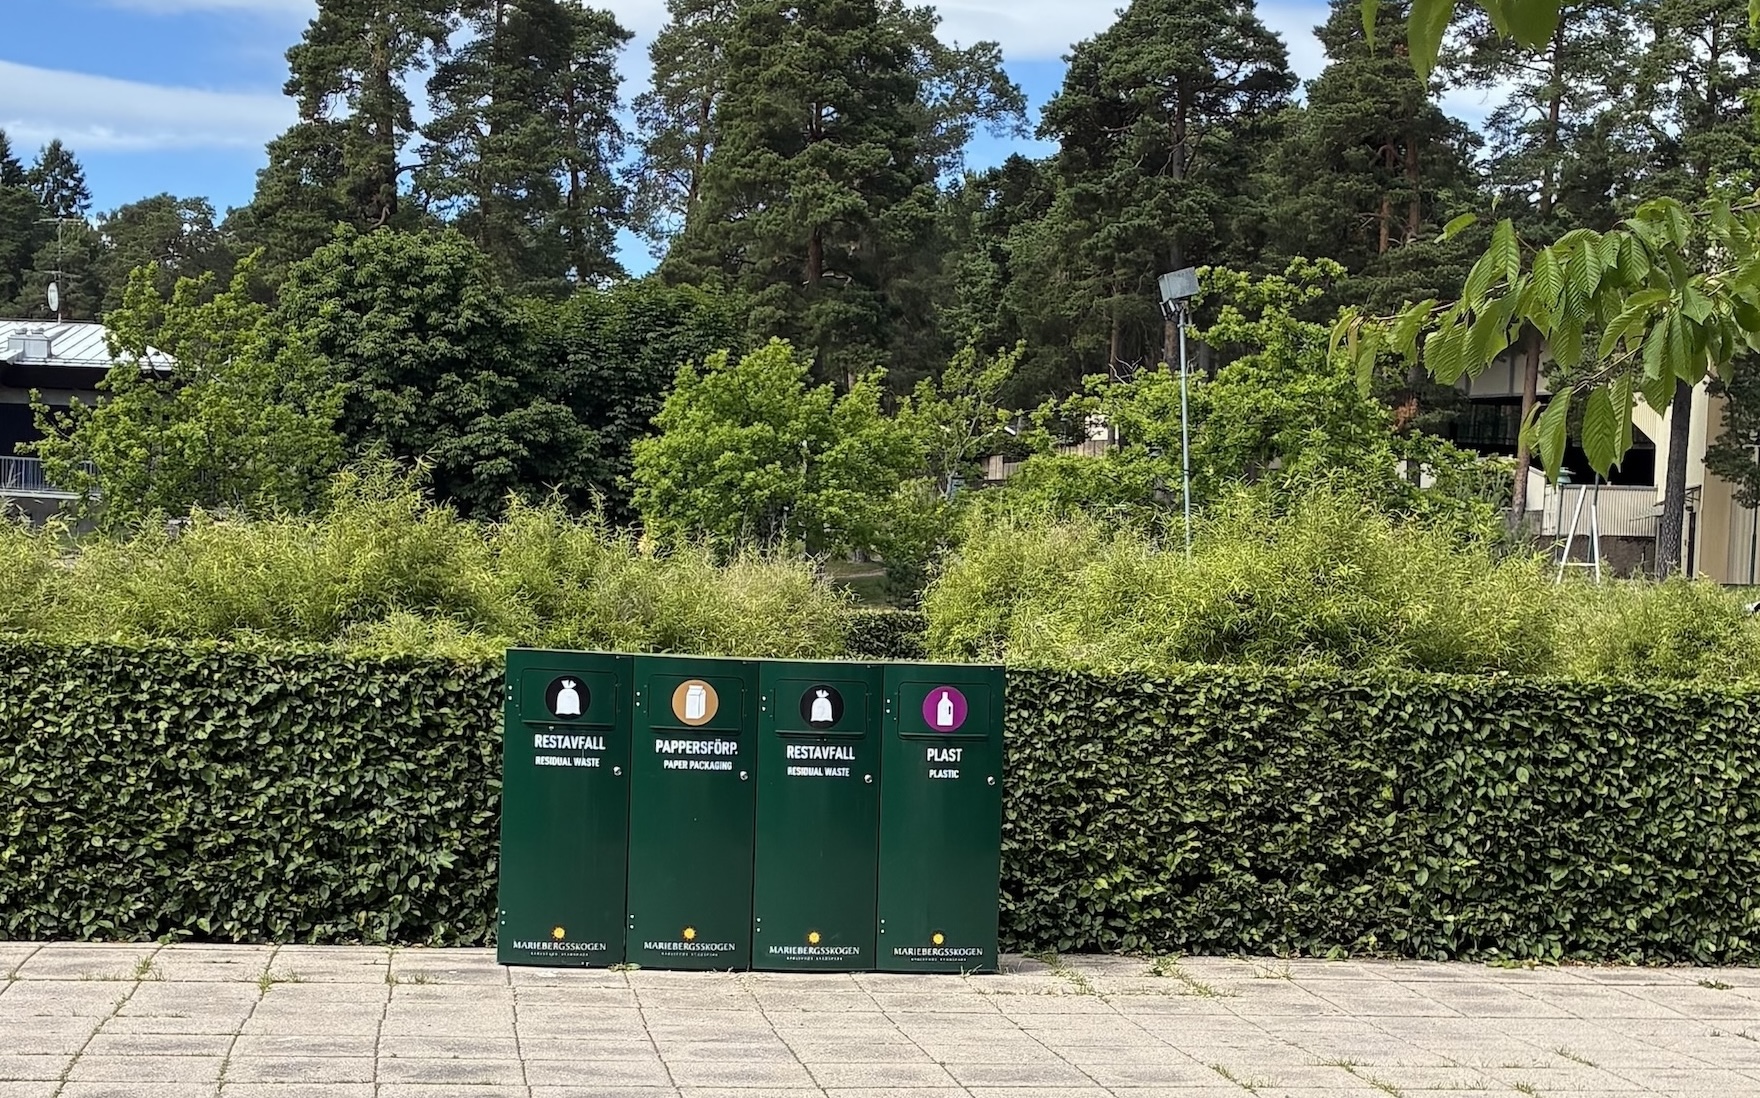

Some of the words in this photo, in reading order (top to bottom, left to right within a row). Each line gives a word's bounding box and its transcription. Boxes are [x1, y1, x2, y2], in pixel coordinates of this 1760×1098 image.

[534, 734, 607, 751] RESTAVFALL
[655, 738, 739, 755] PAPPERSFÖRP.
[786, 744, 856, 761] RESTAVFALL
[926, 747, 963, 763] PLAST
[535, 755, 571, 767] RESIDUAL
[573, 756, 600, 768] WASTE
[663, 759, 688, 769] PAPER
[690, 760, 733, 771] PACKAGING
[787, 766, 823, 777] RESIDUAL
[825, 767, 850, 778] WASTE
[929, 768, 960, 779] PLASTIC
[513, 940, 607, 951] MARIEBERGSSKOGEN
[643, 941, 736, 951] MARIEBERGSSKOGEN
[769, 945, 860, 955] MARIEBERGSSKOGEN
[893, 947, 983, 957] MARIEBERGSSKOGEN
